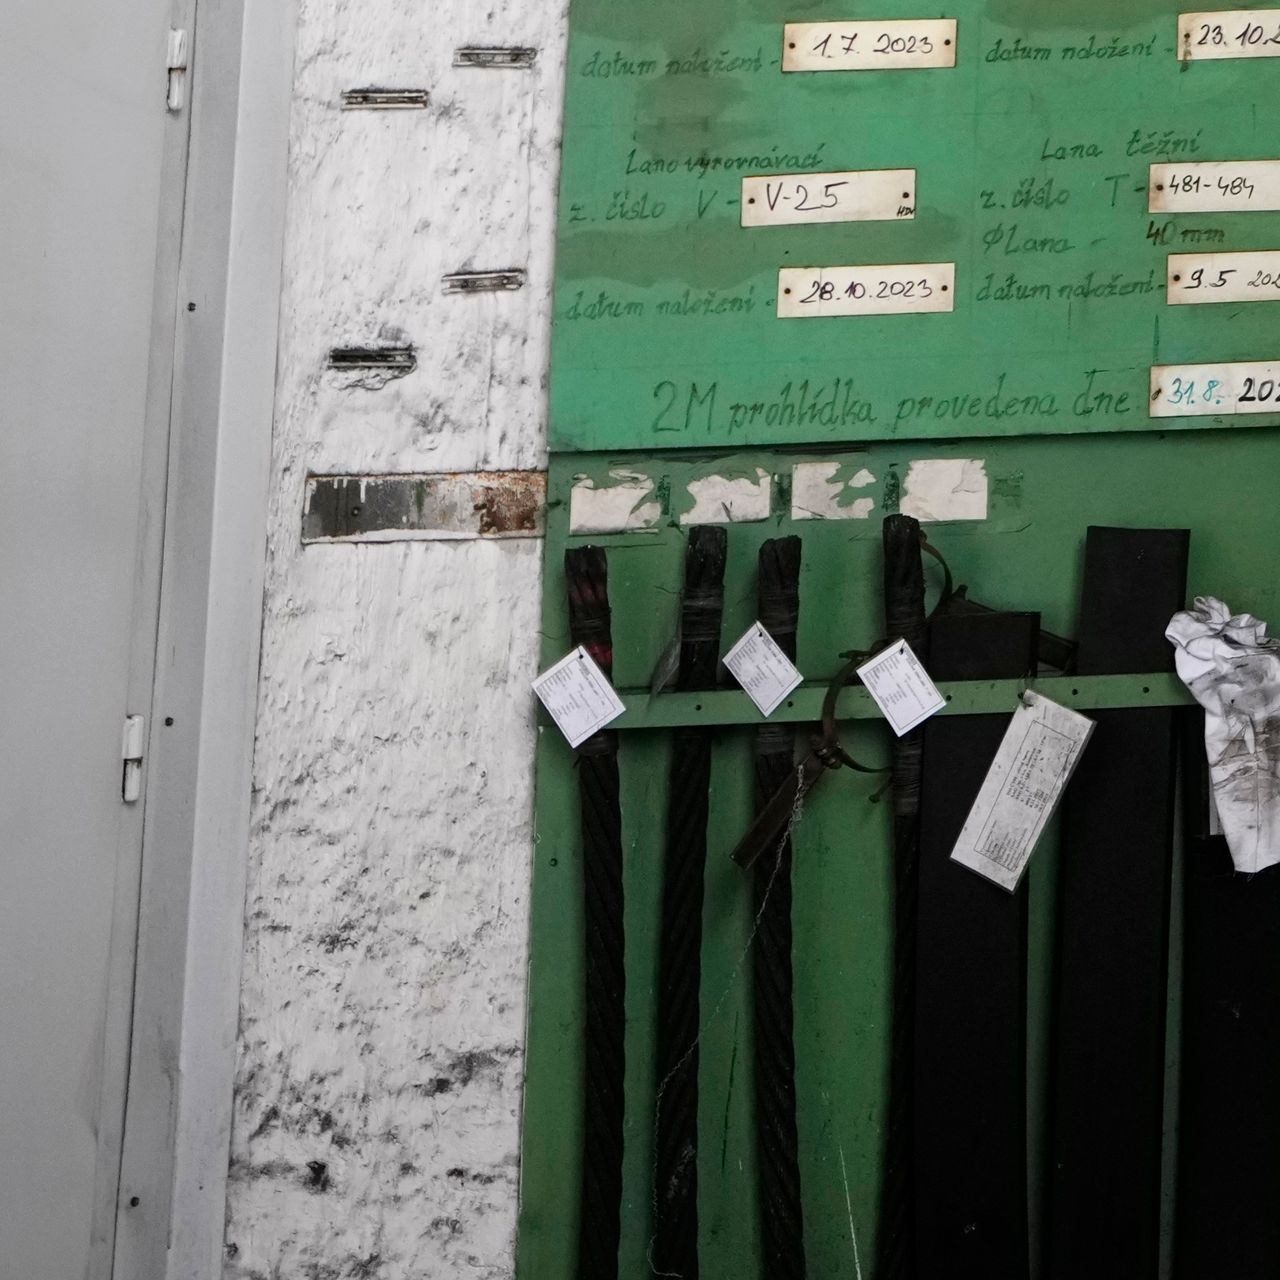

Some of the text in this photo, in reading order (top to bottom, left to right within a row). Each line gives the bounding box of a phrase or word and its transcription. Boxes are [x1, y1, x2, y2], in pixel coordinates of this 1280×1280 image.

[873, 32, 934, 55] 2023
[985, 38, 1052, 64] datum
[625, 148, 678, 175] Lano
[1040, 138, 1104, 162] Lana
[606, 190, 667, 221] číslo
[766, 181, 849, 212] V-25
[1012, 177, 1071, 209] číslo
[976, 273, 1051, 302] datum
[653, 380, 718, 434] 2M
[728, 377, 878, 436] prohlídka
[1070, 368, 1131, 417] dne
